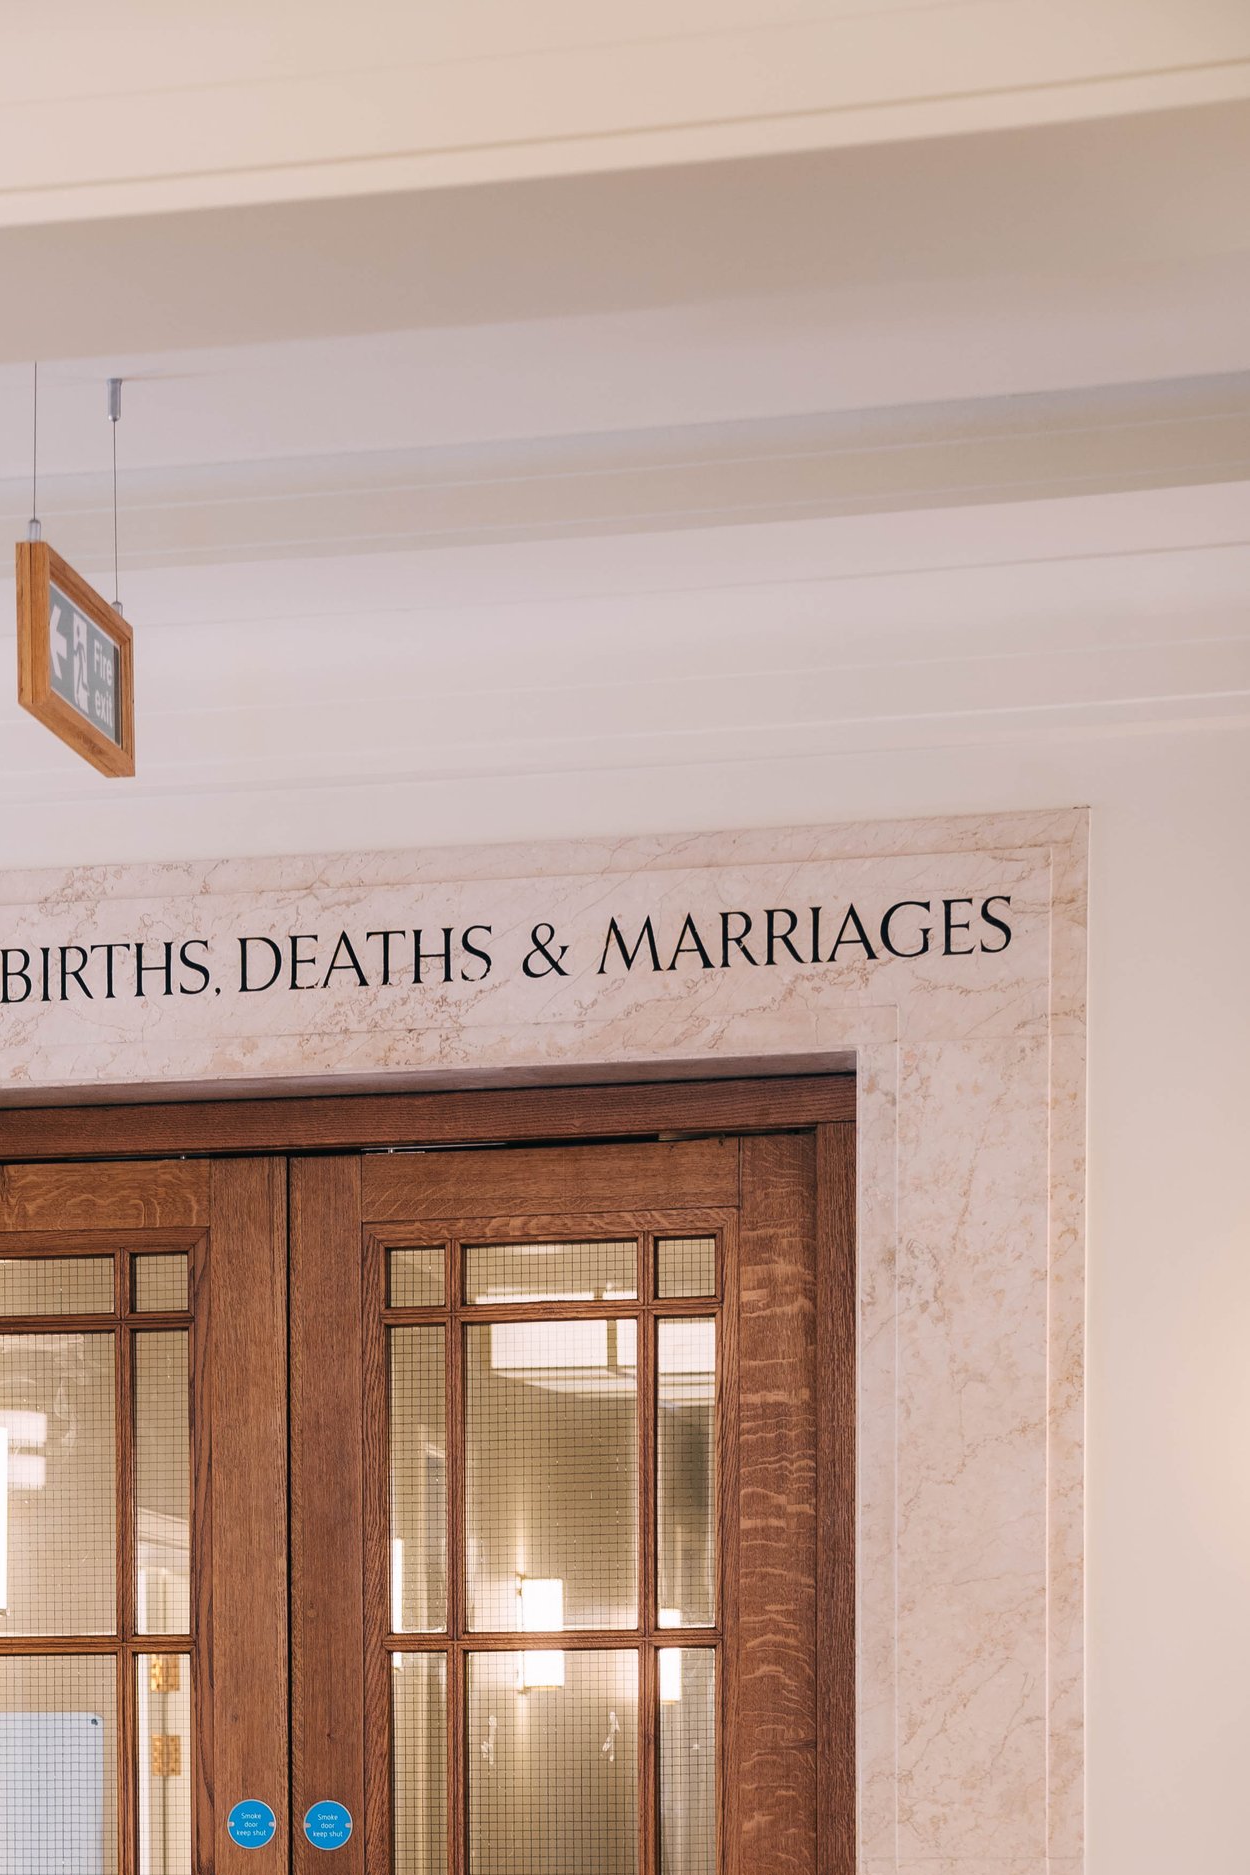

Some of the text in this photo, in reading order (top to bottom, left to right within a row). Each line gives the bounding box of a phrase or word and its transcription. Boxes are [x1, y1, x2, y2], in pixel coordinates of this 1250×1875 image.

[93, 639, 112, 687] Fire
[94, 690, 113, 728] exit
[0, 939, 221, 1004] BIRTHS,
[238, 924, 492, 993] DEATHS
[522, 922, 570, 979] &
[596, 895, 1012, 975] MARRIAGES
[241, 1812, 262, 1820] Smoke
[317, 1813, 339, 1821] Smoke
[320, 1821, 335, 1829] door
[236, 1829, 267, 1837] keep shut
[312, 1831, 328, 1839] keep
